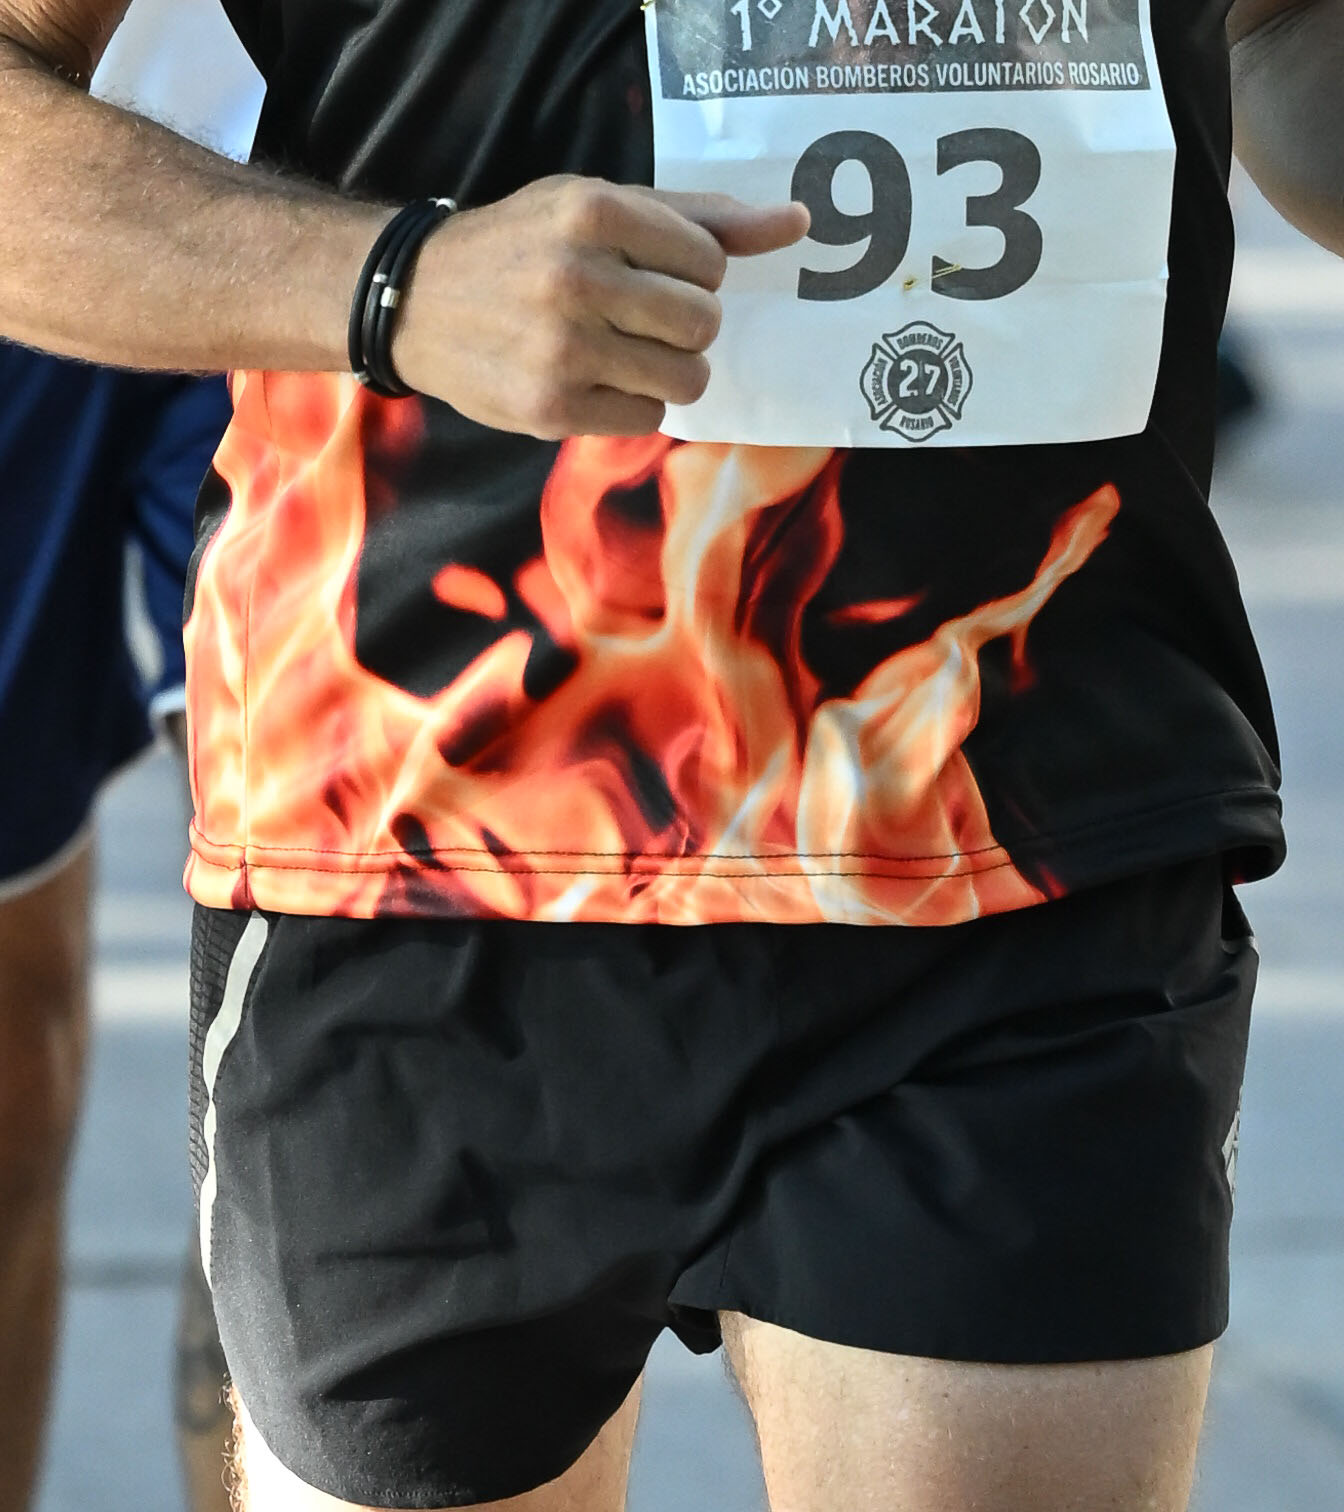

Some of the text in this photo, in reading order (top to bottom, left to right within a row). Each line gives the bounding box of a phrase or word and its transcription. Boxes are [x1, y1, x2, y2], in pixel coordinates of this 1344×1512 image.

[682, 59, 1140, 96] ASOCIACIÓN BOMBEROS VOLUNTARIOS ROSARIO
[790, 127, 1044, 302] 93
[899, 359, 941, 398] 27
